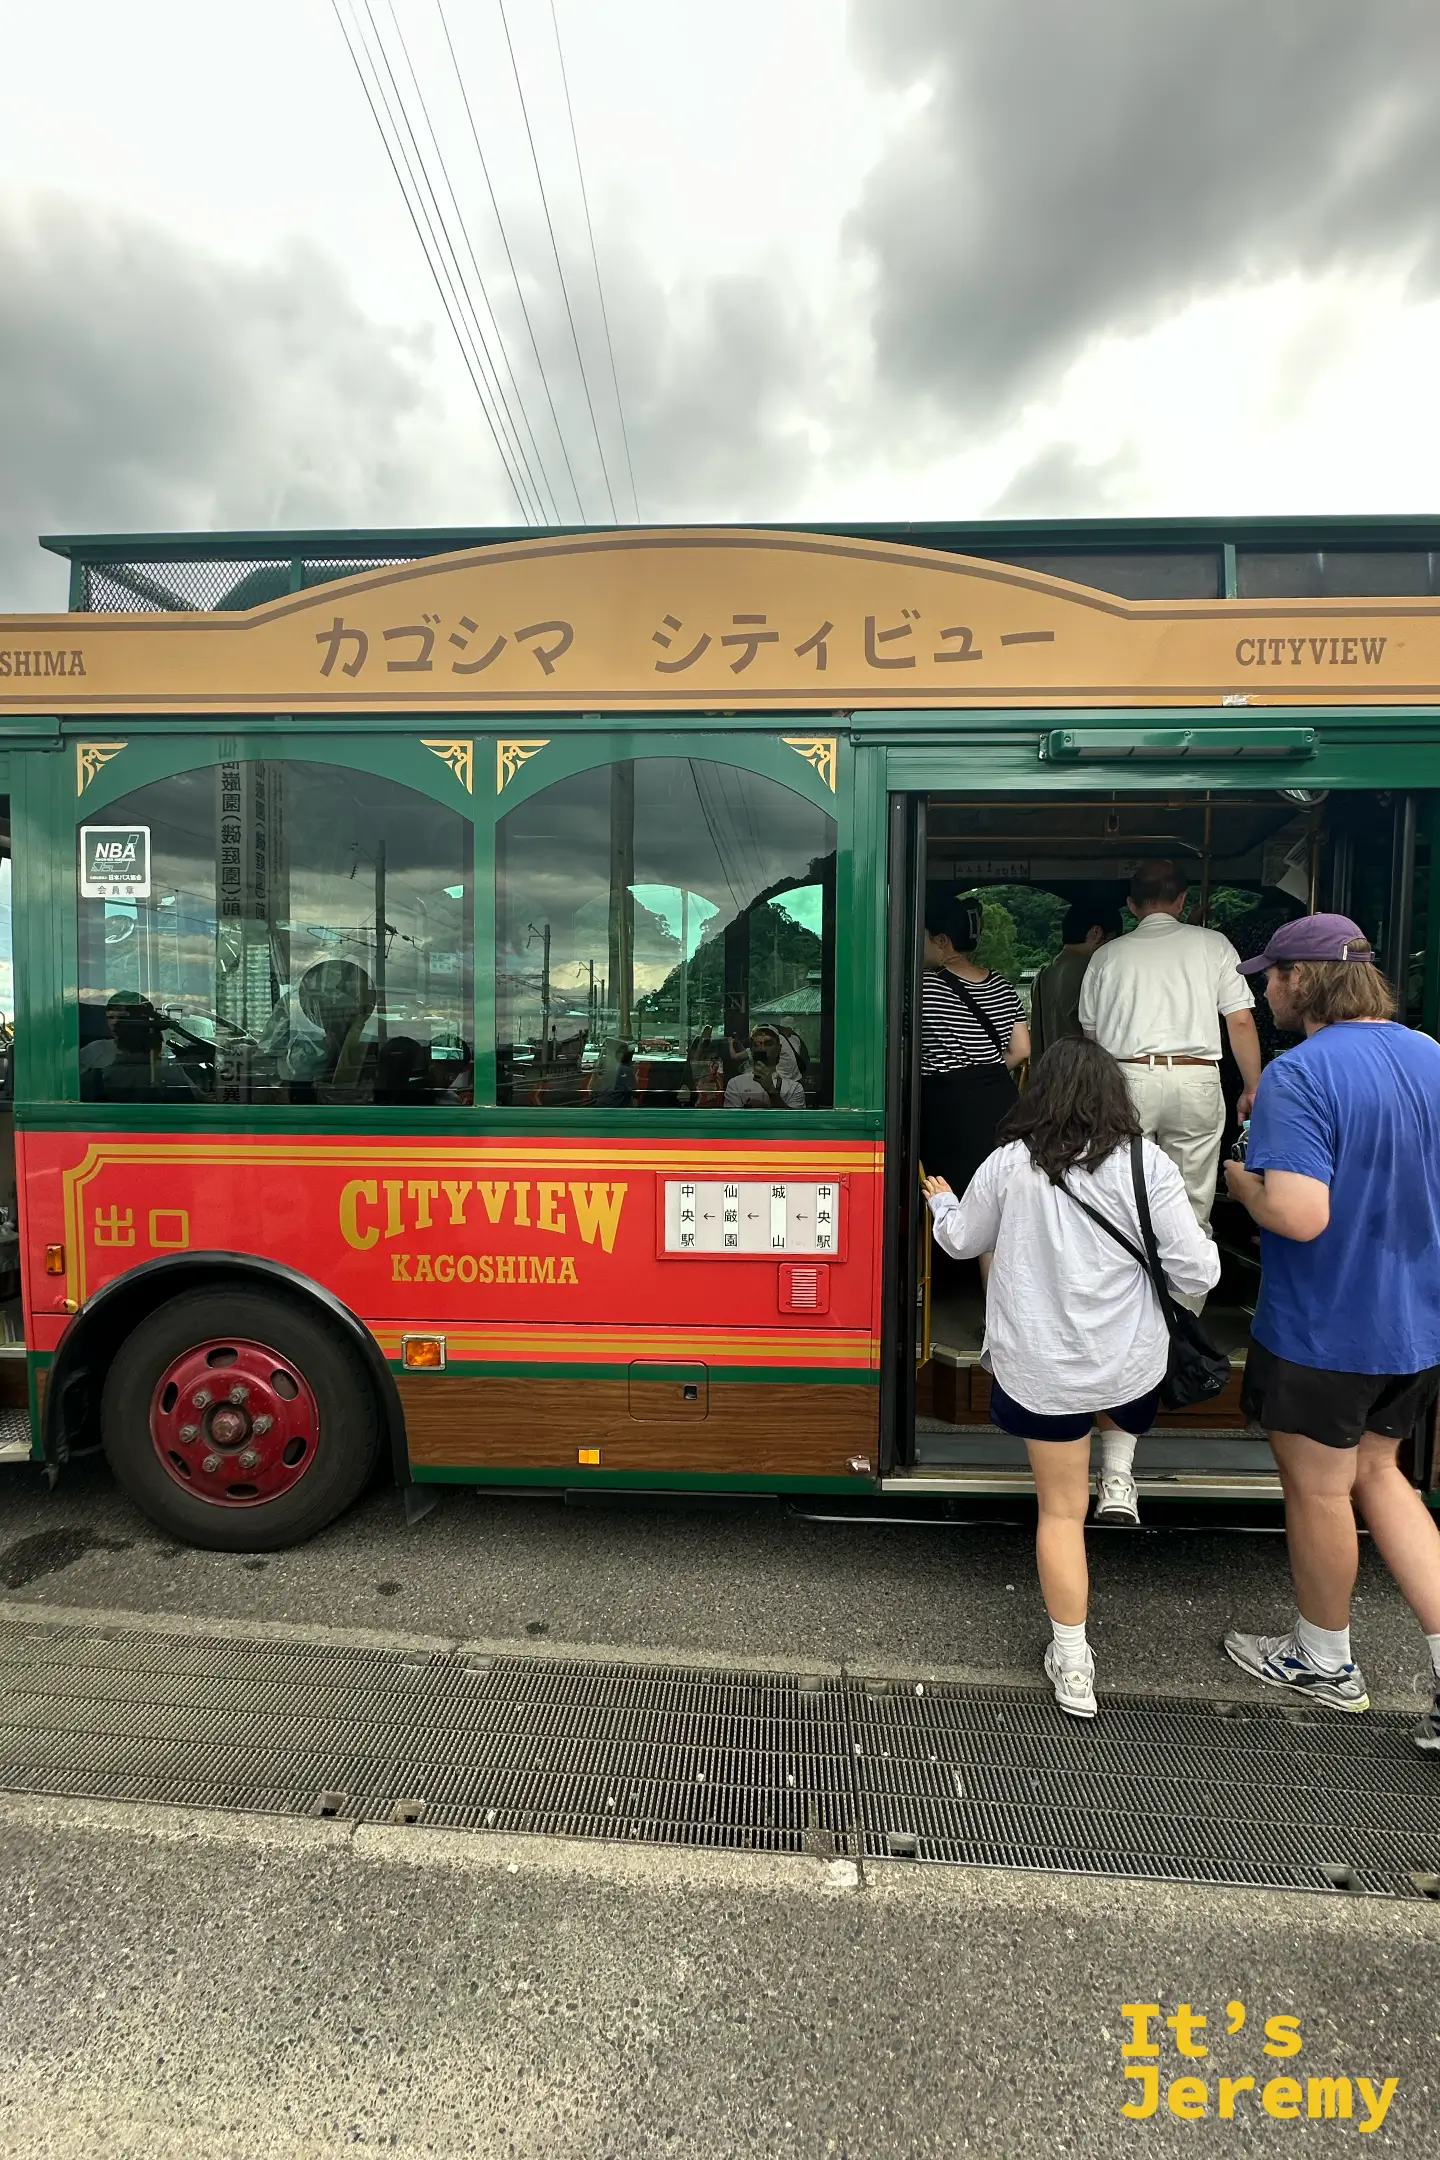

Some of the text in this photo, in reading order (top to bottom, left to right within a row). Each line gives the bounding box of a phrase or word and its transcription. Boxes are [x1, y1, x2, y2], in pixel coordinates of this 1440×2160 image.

[316, 608, 1056, 678] カゴシマ シティビュー
[1235, 637, 1388, 667] CITYVIEW
[95, 842, 136, 859] NBA
[94, 1204, 190, 1247] 出口
[339, 1179, 628, 1254] CITYVIEW
[681, 1185, 695, 1247] 中央駅
[772, 1186, 786, 1248] 城山
[817, 1186, 831, 1248] 中央駅
[391, 1254, 579, 1284] KAGOSHIMA
